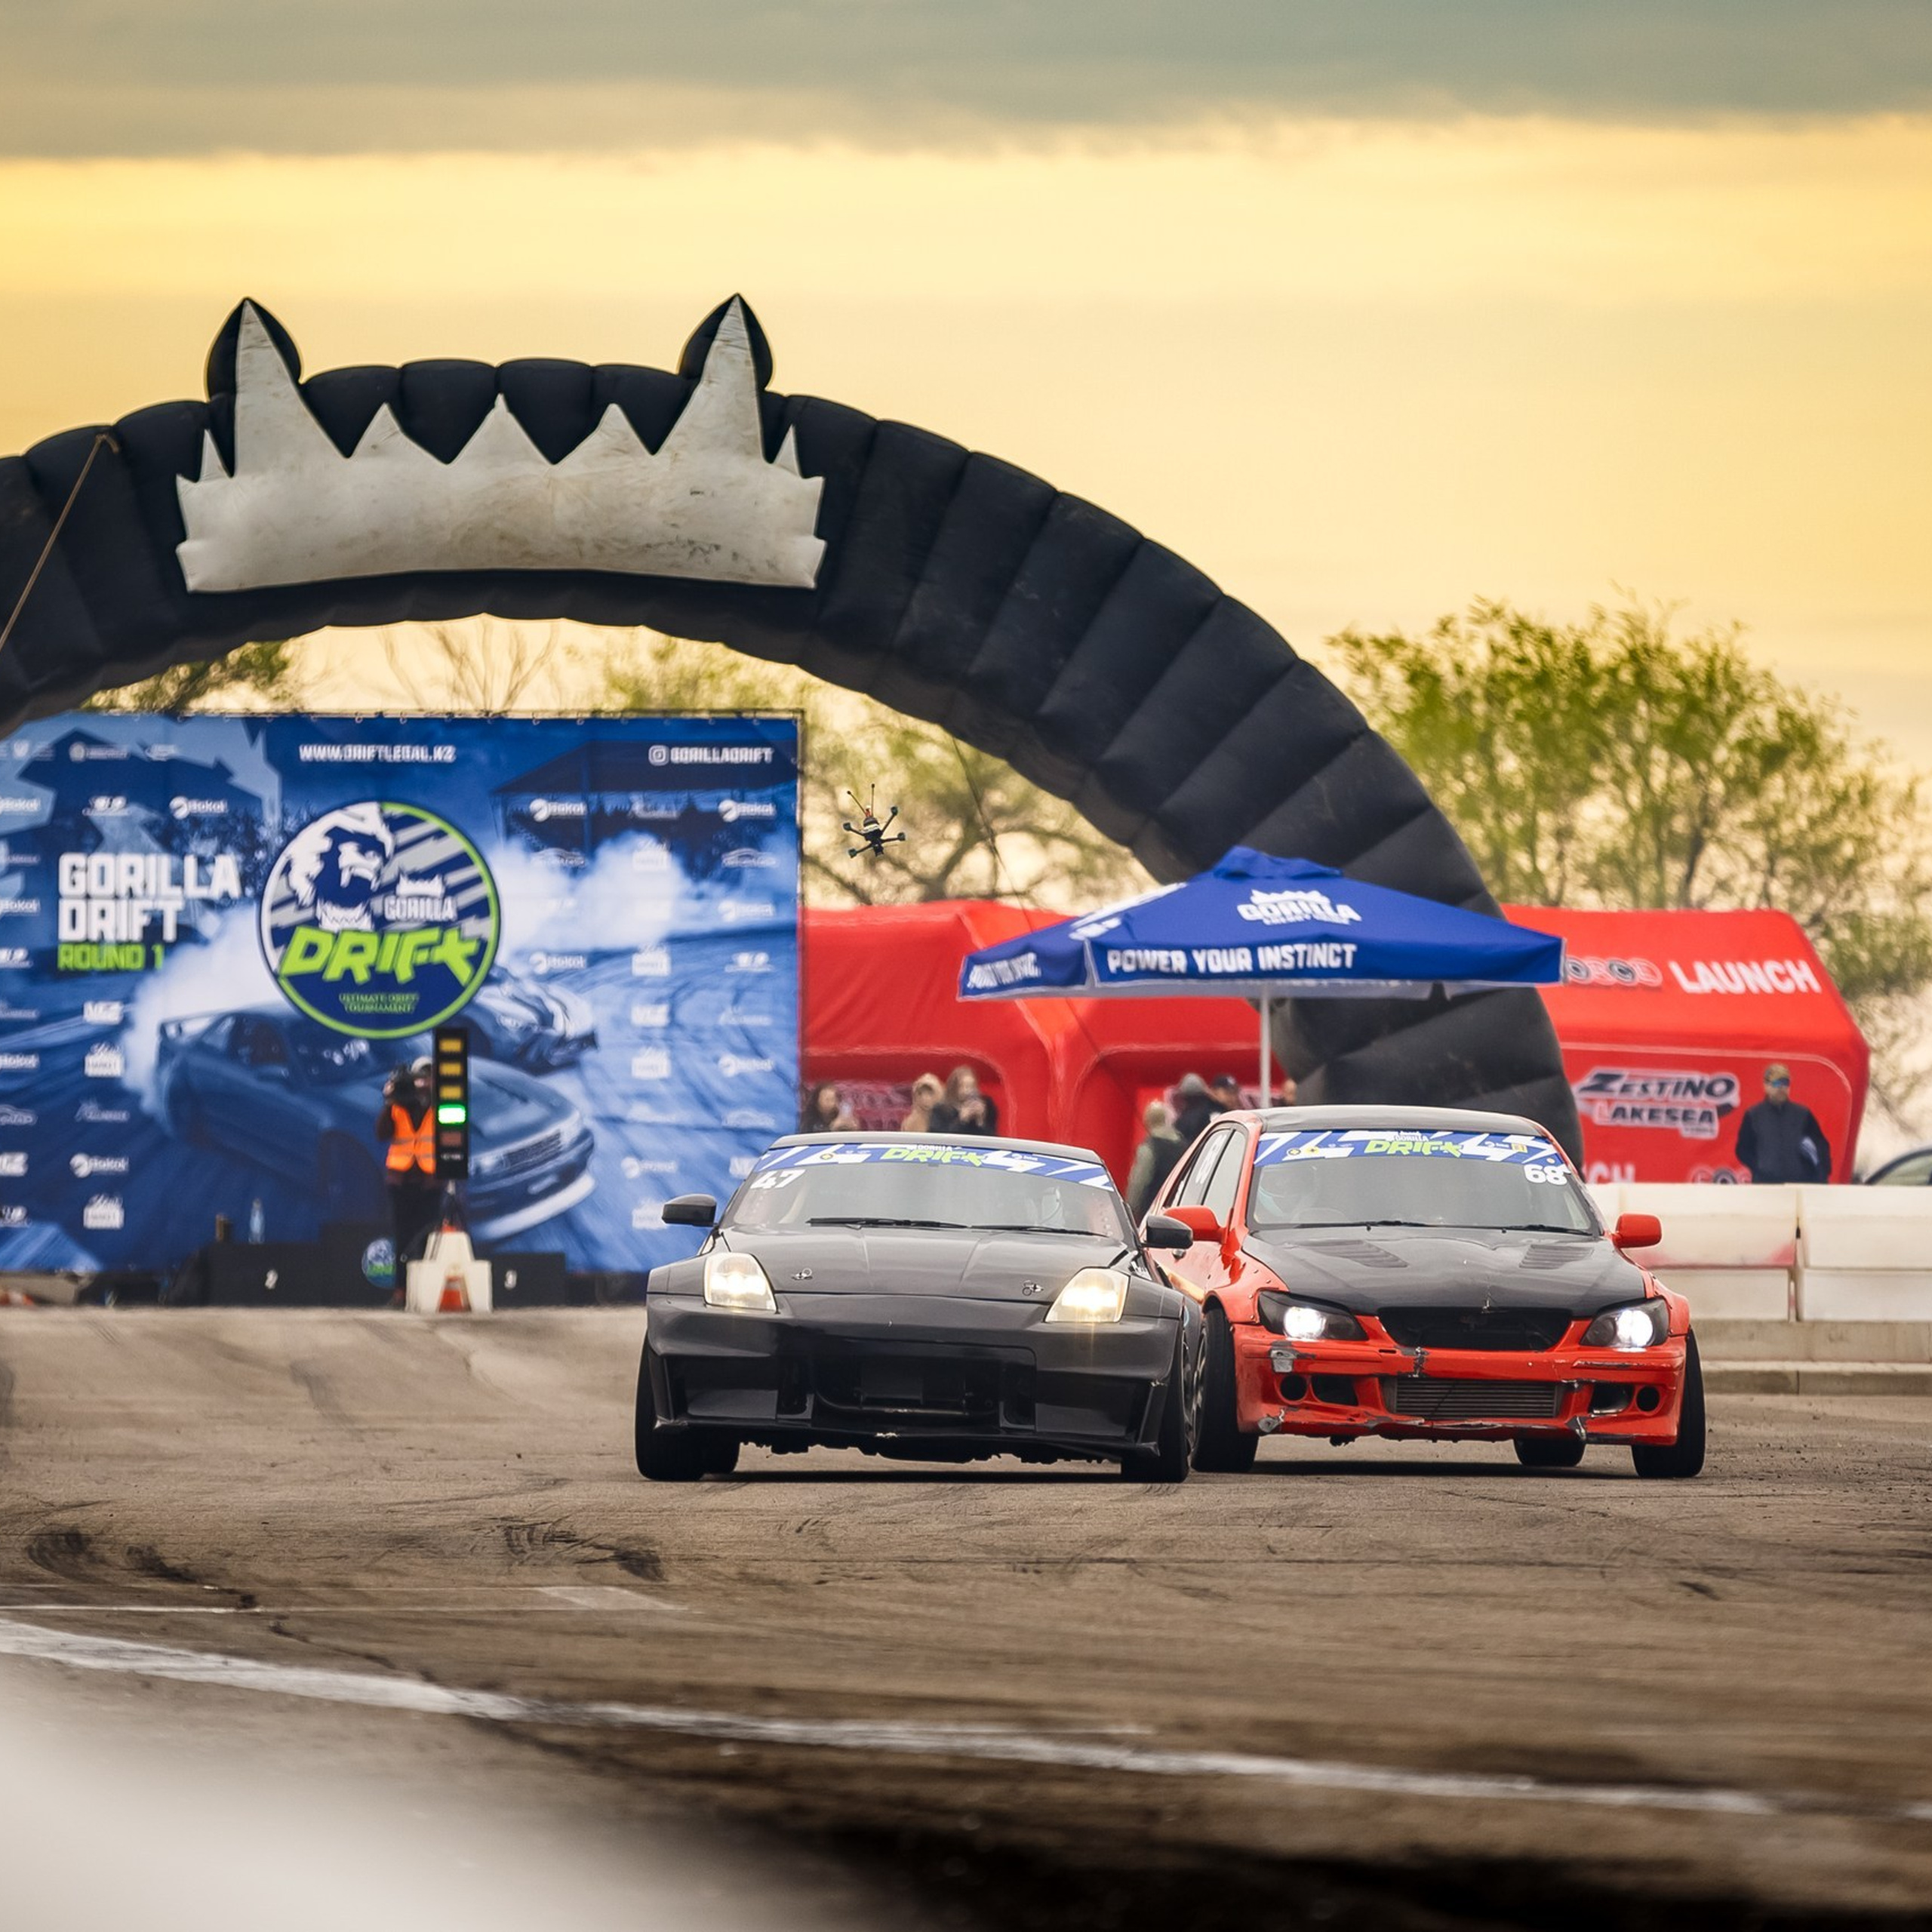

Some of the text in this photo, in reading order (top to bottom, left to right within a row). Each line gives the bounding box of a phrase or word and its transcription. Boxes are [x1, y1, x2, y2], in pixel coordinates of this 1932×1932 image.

[670, 746, 774, 764] GORILLADRIFT
[59, 853, 242, 899] GORILLA
[59, 898, 183, 943] DRIFT
[383, 895, 458, 921] GORILLA
[1236, 898, 1362, 925] GORILLA
[58, 943, 146, 971] ROUND
[152, 943, 165, 971] 1
[1106, 943, 1357, 974] POWER YOUR INSTINCT
[1668, 959, 1822, 994] LAUNCH
[1578, 1072, 1736, 1099] ZESTINO
[749, 1168, 807, 1189] 47
[1524, 1163, 1567, 1185] 68
